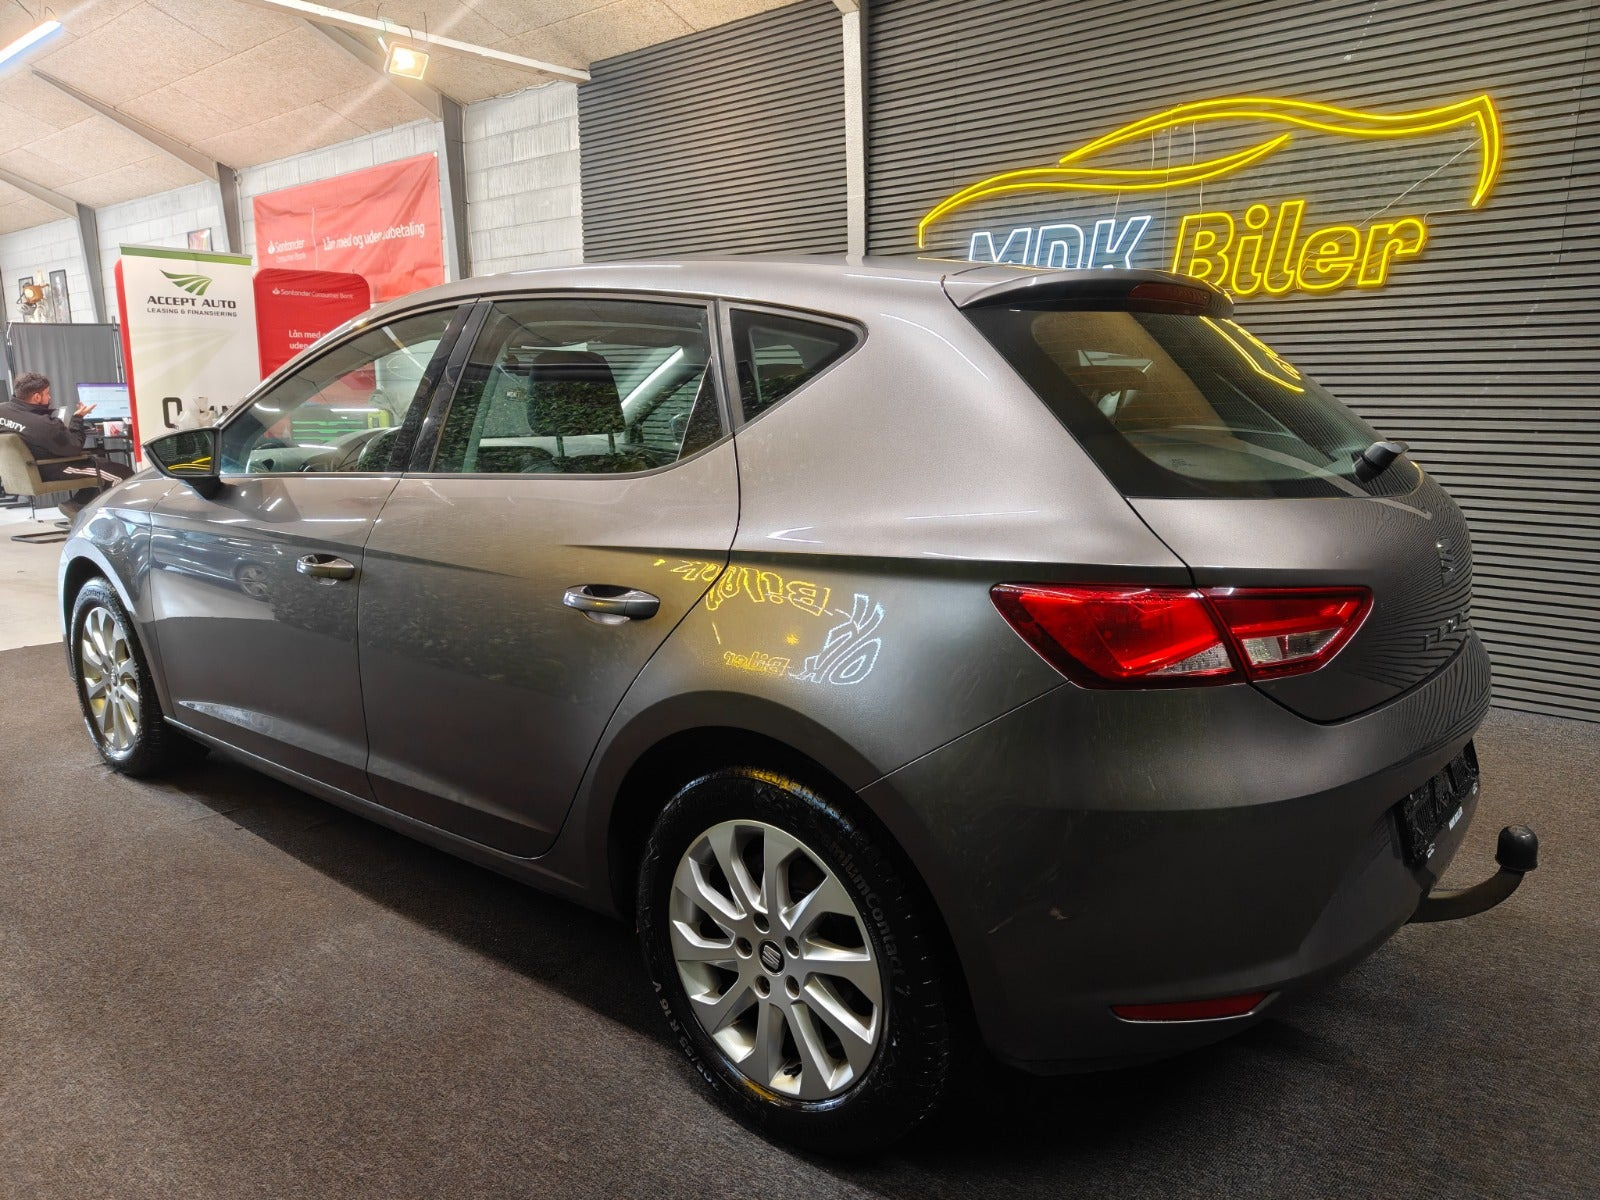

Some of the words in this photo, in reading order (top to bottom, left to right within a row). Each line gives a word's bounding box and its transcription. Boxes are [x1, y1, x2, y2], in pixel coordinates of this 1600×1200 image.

[335, 234, 352, 249] med
[352, 233, 364, 249] og
[1171, 199, 1428, 297] Biler
[280, 288, 311, 297] Santander
[147, 295, 197, 306] ACCEPT
[202, 299, 236, 309] AUTO
[188, 309, 238, 318] FINANSIERING
[288, 329, 303, 338] Lån
[304, 331, 321, 339] med
